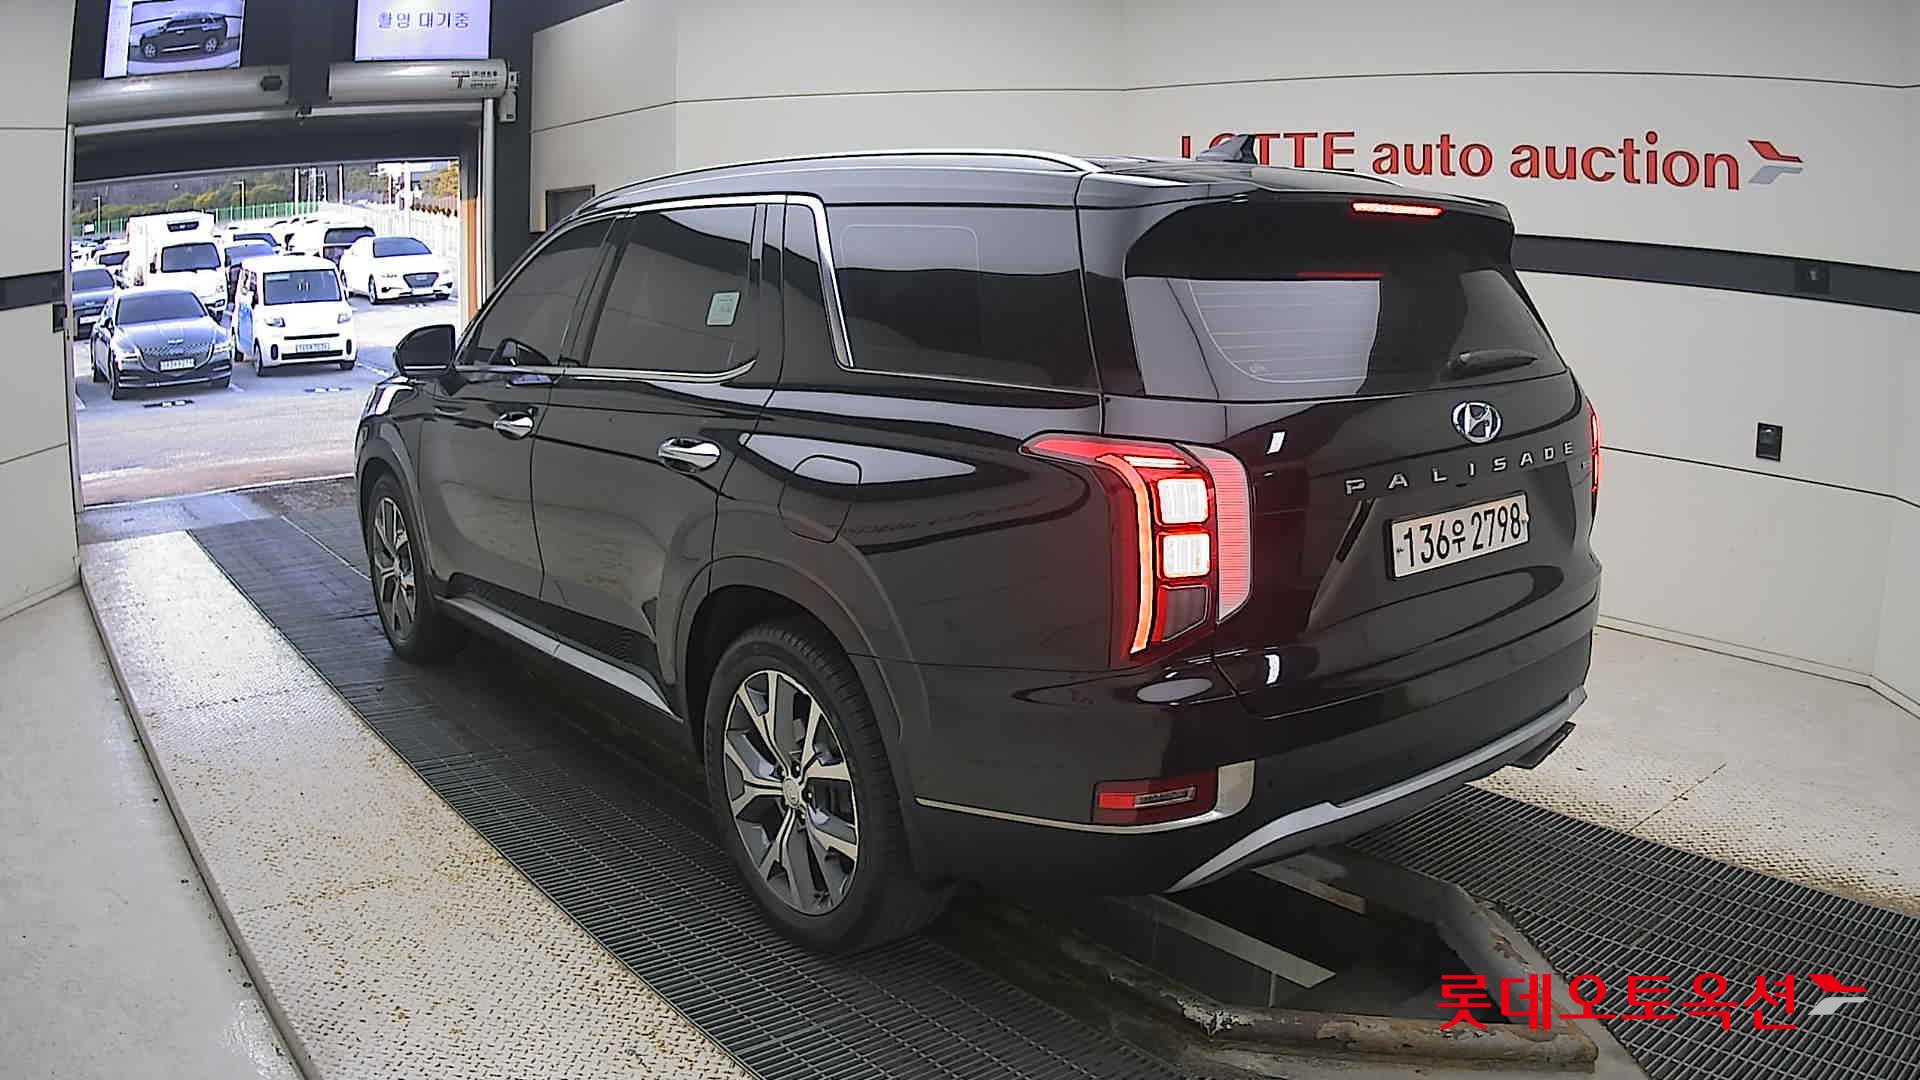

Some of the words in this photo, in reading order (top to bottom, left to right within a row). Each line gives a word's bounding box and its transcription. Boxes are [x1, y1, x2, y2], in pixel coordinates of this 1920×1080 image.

[419, 12, 472, 28] 대기중
[1181, 131, 1355, 172] TTE
[1372, 132, 1494, 178] auto
[1510, 131, 1740, 190] auction
[1345, 440, 1574, 495] PALISADE
